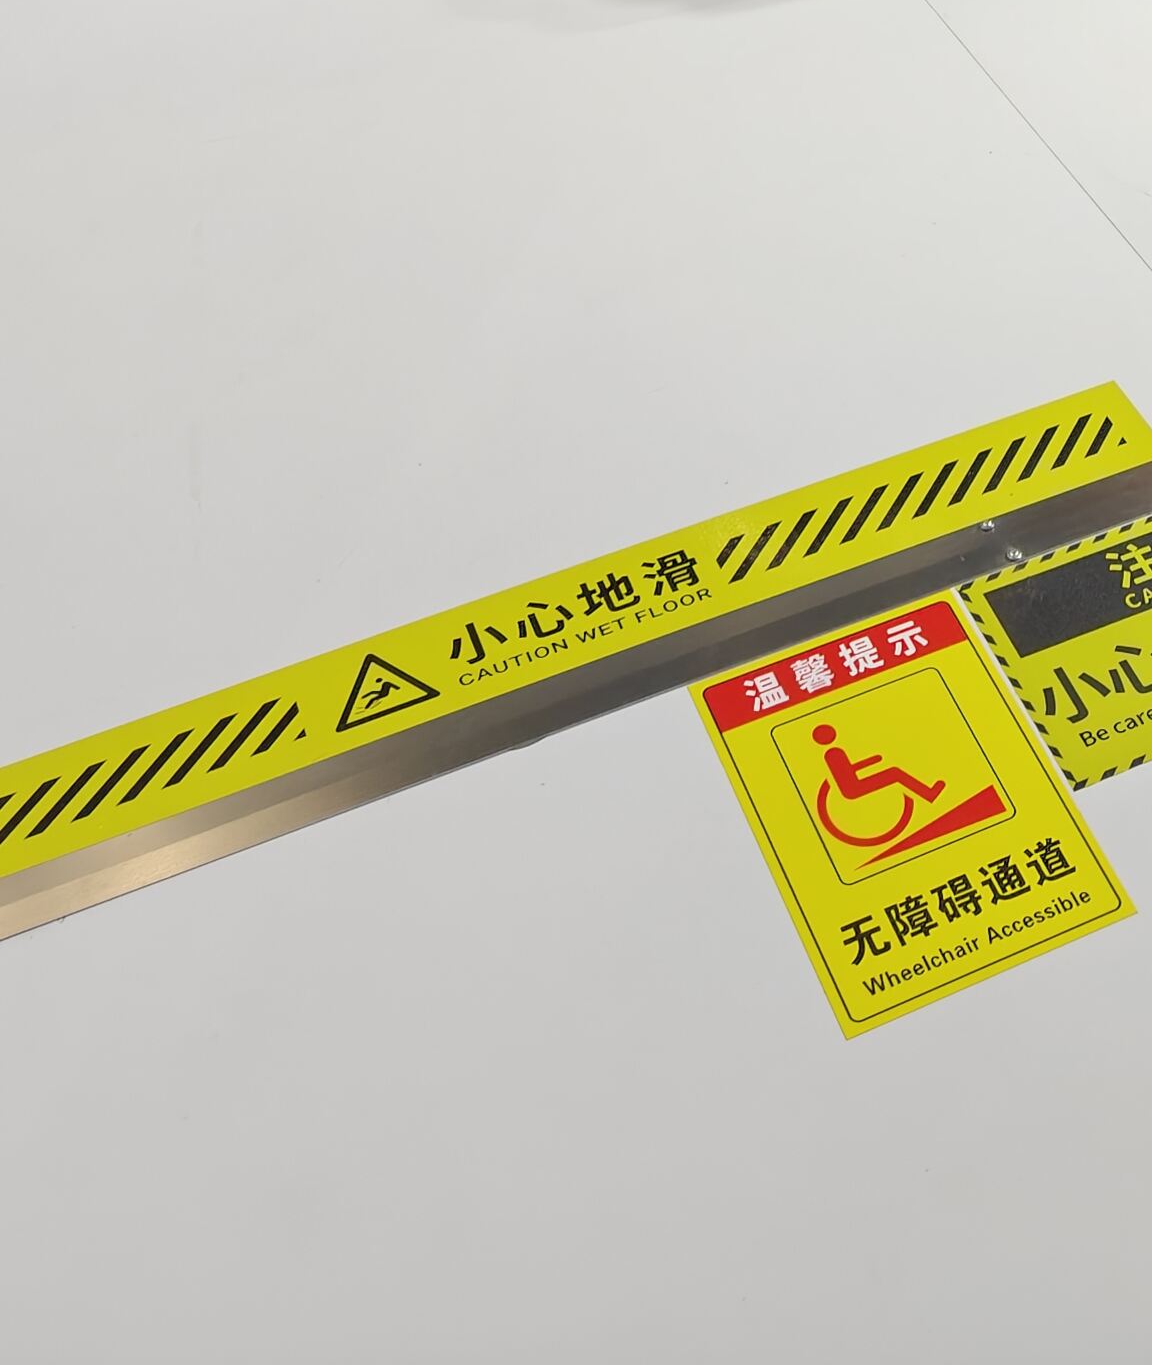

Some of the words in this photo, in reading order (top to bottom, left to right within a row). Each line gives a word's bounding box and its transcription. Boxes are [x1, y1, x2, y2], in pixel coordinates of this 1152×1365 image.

[449, 550, 701, 665] 小心地滑
[458, 638, 569, 687] CAUTION
[575, 617, 626, 644] WET
[635, 587, 713, 624] FLOOR
[743, 620, 929, 712] 温馨提示
[1078, 728, 1110, 748] Be
[840, 837, 1077, 966] 无障碍通道
[862, 935, 981, 997] Wheelchair
[986, 889, 1092, 945] Accessible
